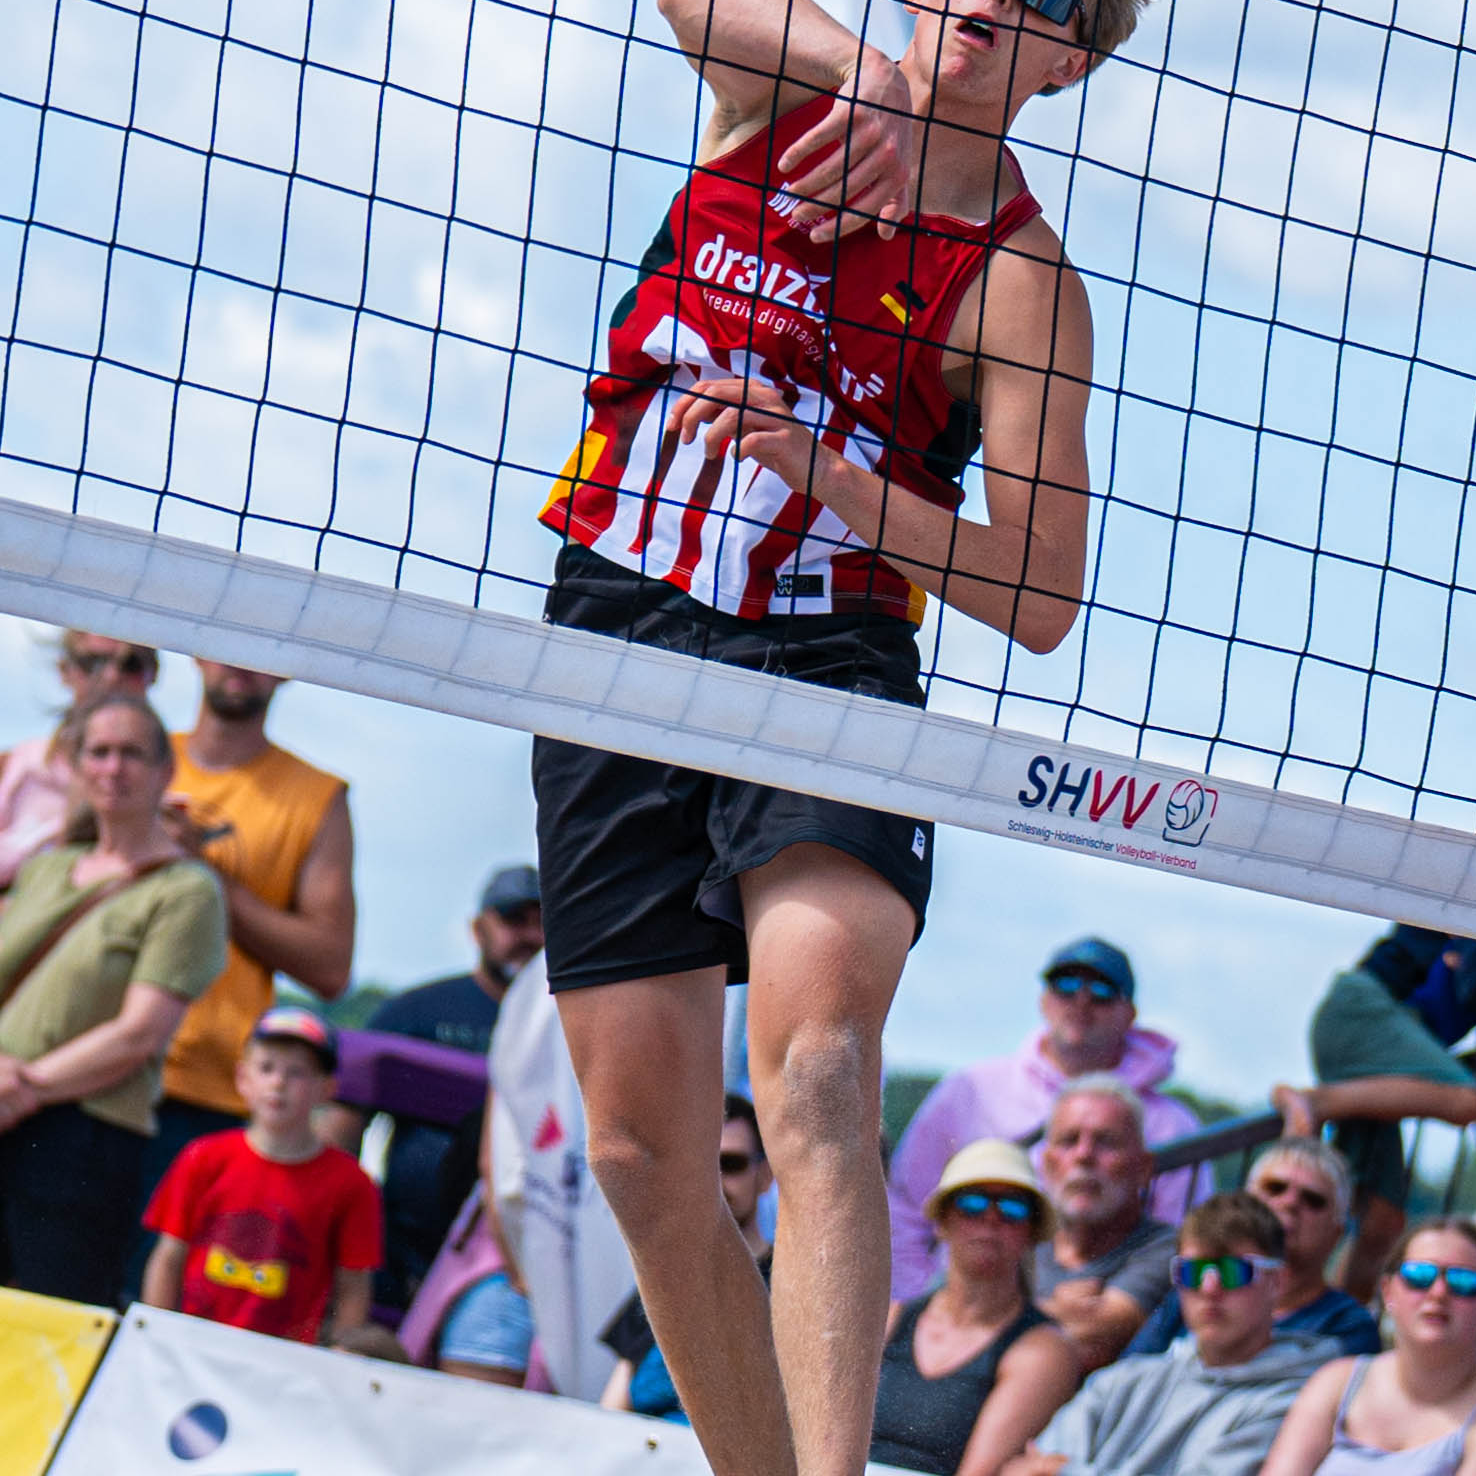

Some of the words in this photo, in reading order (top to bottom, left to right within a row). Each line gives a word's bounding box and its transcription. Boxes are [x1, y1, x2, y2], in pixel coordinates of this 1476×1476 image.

[1018, 755, 1160, 830] SHVV
[1007, 819, 1115, 852] Schleswig-Holsteinischer
[1116, 843, 1197, 870] Volleyball-Verband
